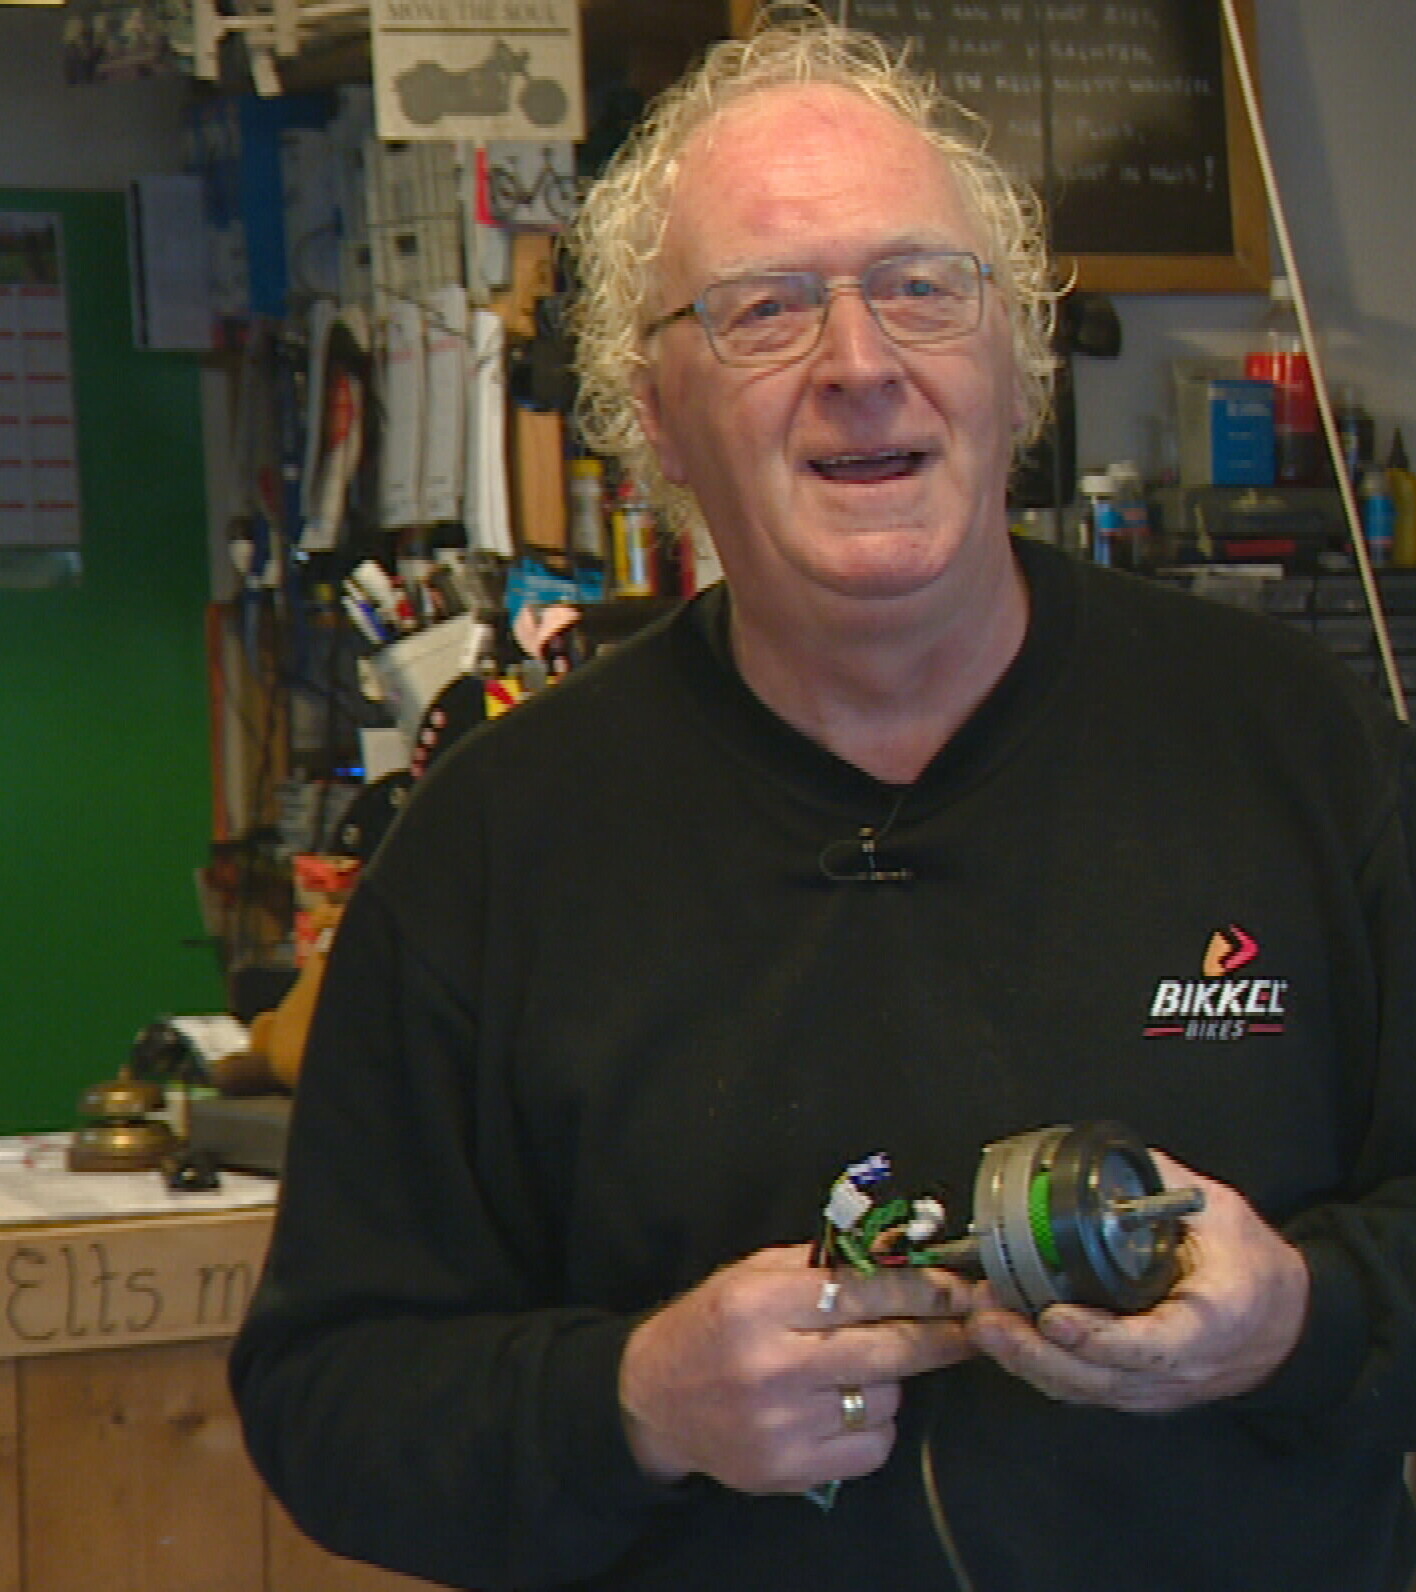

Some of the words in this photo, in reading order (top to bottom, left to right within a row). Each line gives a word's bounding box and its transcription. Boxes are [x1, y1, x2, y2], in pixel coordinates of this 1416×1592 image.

[1150, 978, 1286, 1016] BIKKEL
[1185, 1020, 1247, 1040] BIKES
[5, 1244, 164, 1341] Elts
